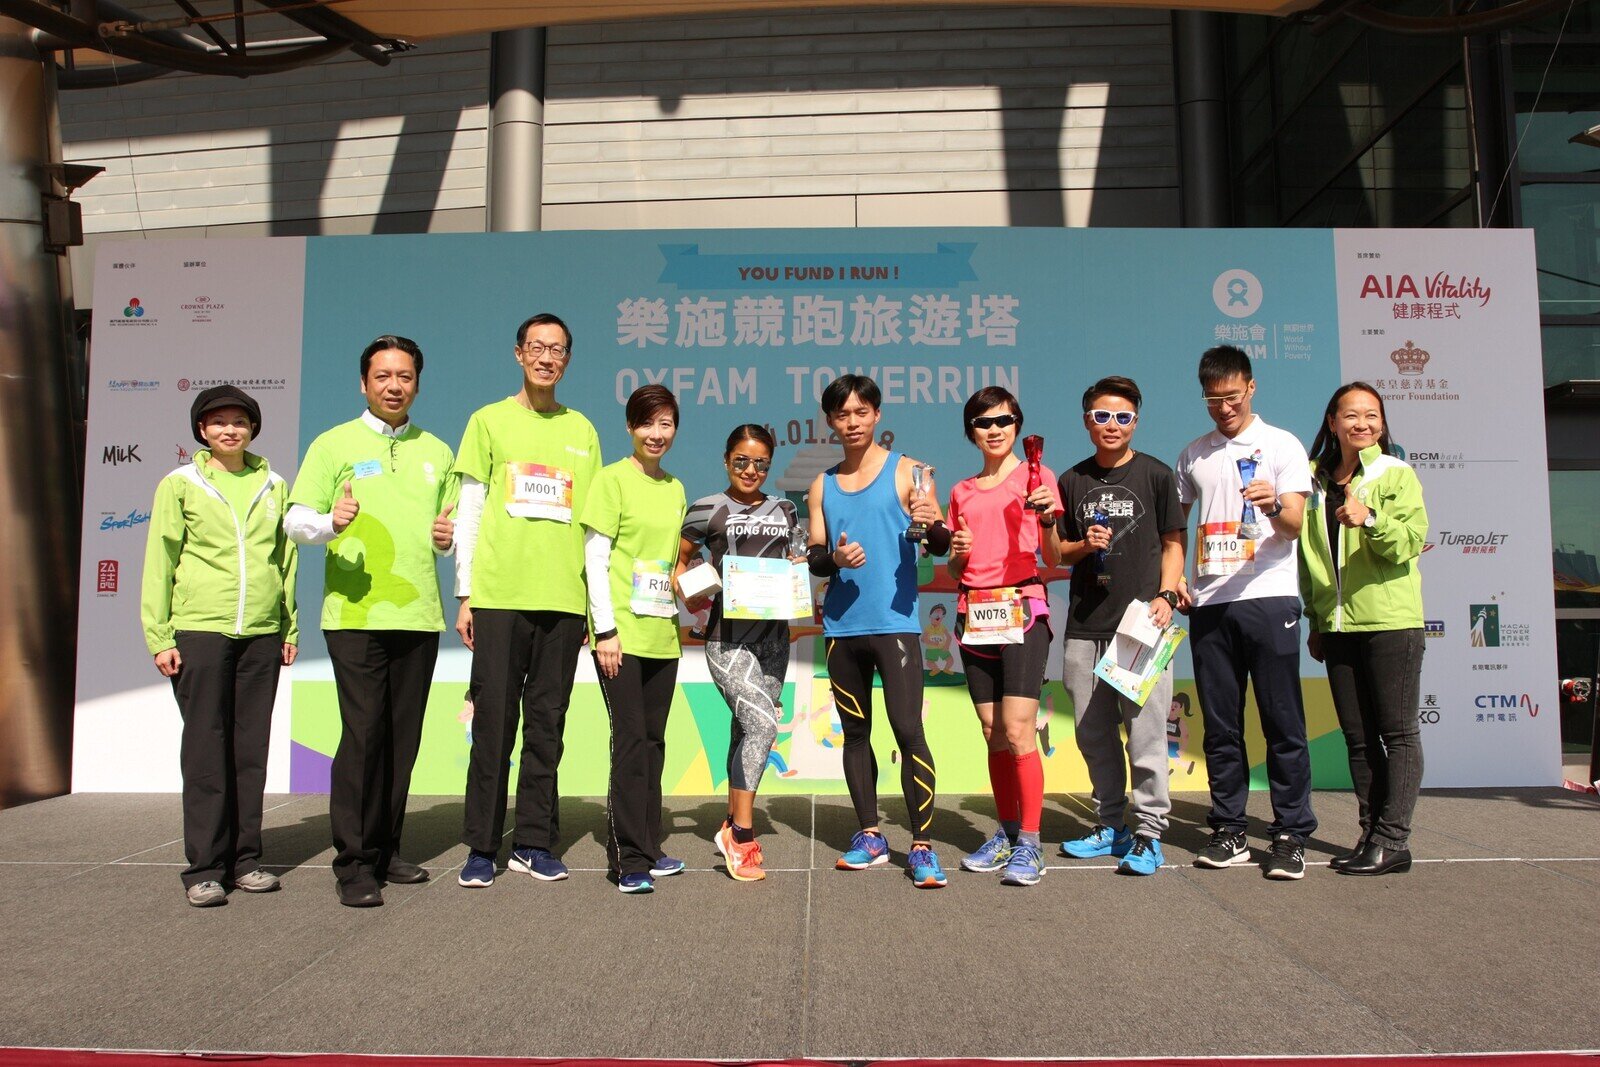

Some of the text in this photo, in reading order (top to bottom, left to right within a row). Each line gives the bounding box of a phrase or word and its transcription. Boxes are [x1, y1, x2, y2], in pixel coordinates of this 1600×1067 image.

[738, 267, 779, 281] YOU
[784, 267, 834, 281] FUND
[839, 267, 845, 280] I
[850, 266, 888, 280] RUN
[1360, 270, 1491, 307] AIA Vitality
[1392, 302, 1461, 320] 健康程式
[616, 293, 1020, 348] 樂施競跑旅遊塔
[1214, 323, 1267, 342] 樂施會
[1284, 335, 1304, 343] World
[1284, 353, 1311, 362] Poverty
[1375, 378, 1449, 389] 英皇慈善基金
[1408, 391, 1460, 401] Foundation
[524, 481, 557, 496] M001
[726, 525, 760, 537] HONG
[648, 578, 672, 592] R10
[973, 608, 1008, 621] W078
[1474, 694, 1517, 708] CTM
[1475, 713, 1518, 722] 澳門電訊
